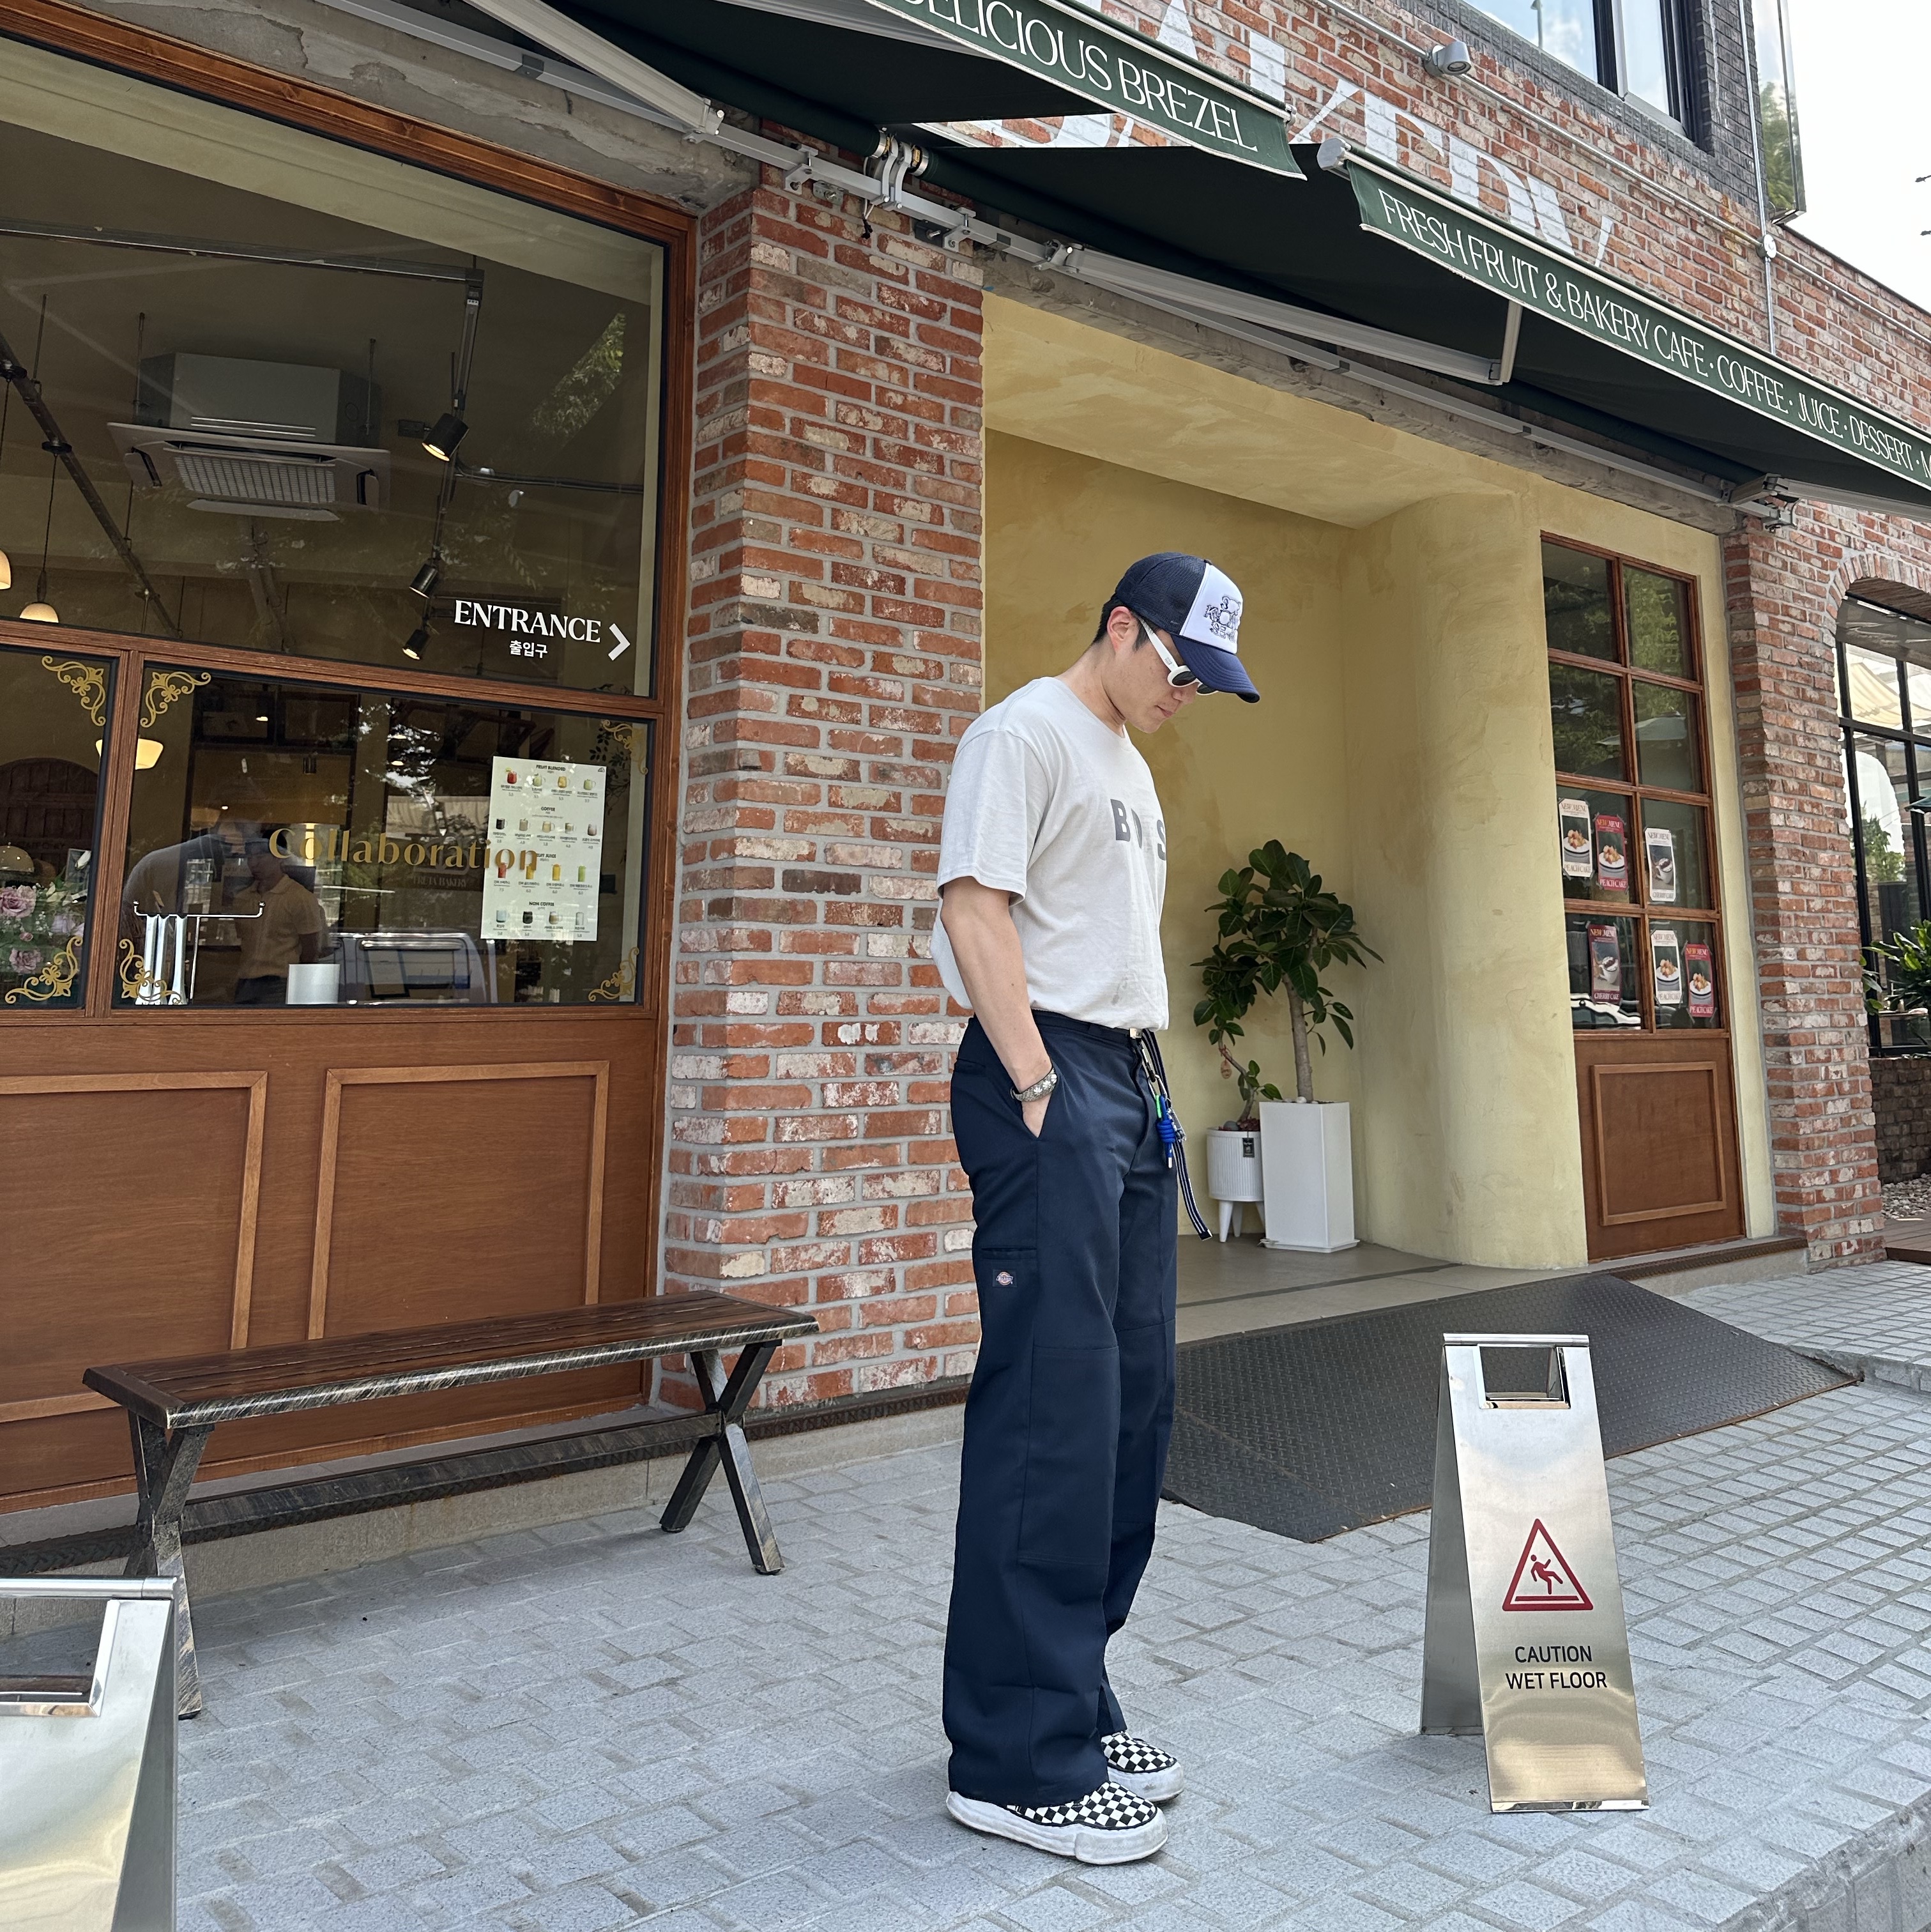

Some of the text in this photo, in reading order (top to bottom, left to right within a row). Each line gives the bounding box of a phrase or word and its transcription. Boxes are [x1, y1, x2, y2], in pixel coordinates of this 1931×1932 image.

[904, 0, 1258, 153] ELICIOUS BREZEL
[1377, 188, 1467, 266] FRESH
[1468, 234, 1538, 298] FRUIT
[1545, 272, 1566, 313] &
[1566, 281, 1650, 350] BAKERY
[1654, 324, 1708, 378] CAFE
[1716, 355, 1789, 414] COFFEE
[1798, 392, 1844, 439] JUICE
[1849, 415, 1914, 471] DESSERT
[454, 599, 601, 643] ENTRANCE
[509, 640, 548, 659] 출입구
[1608, 820, 1622, 829] MENU
[268, 828, 537, 871] Collaboration
[1599, 878, 1615, 887] PEACH
[1515, 1645, 1592, 1662] CAUTION
[1505, 1671, 1608, 1689] WET FLOOR
